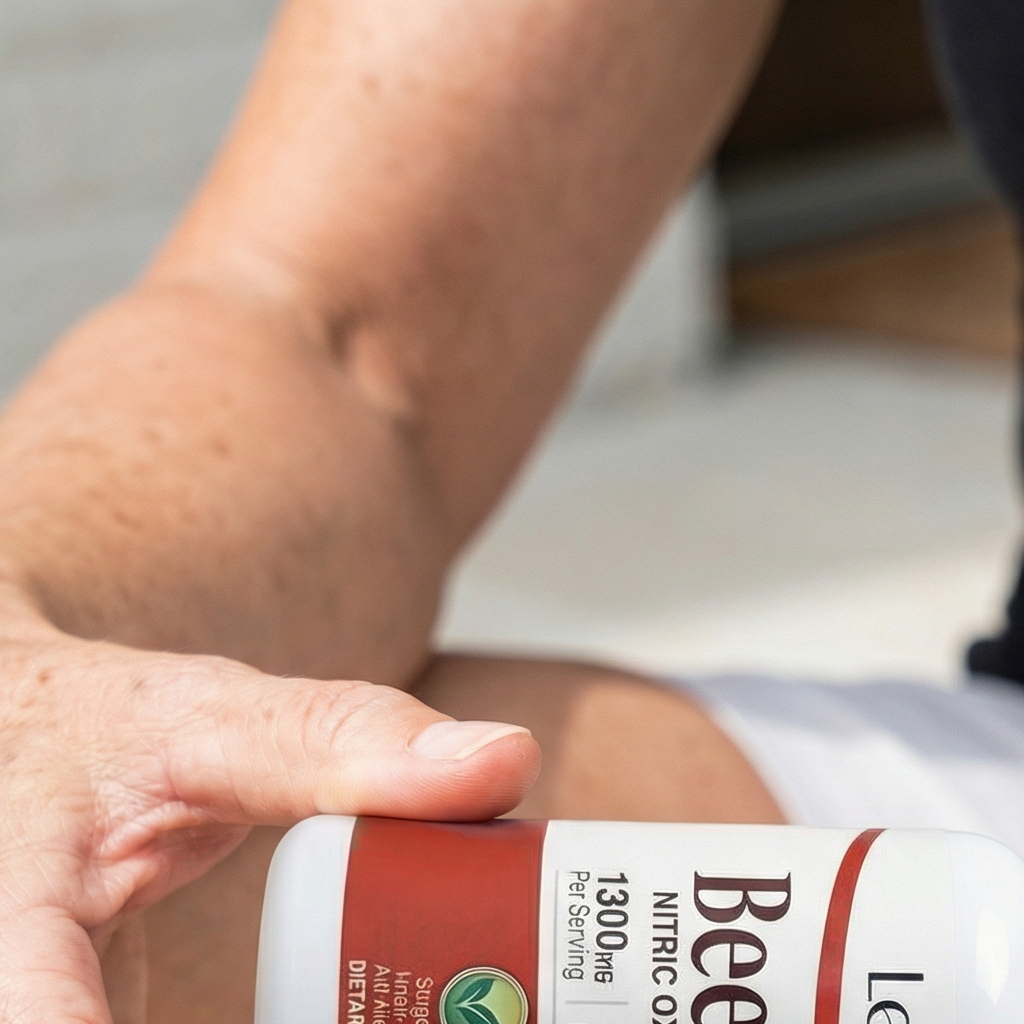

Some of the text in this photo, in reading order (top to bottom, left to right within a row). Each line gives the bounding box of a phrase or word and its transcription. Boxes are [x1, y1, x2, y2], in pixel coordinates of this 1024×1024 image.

[563, 871, 590, 981] Per Serving
[651, 892, 678, 986] NITRIC
